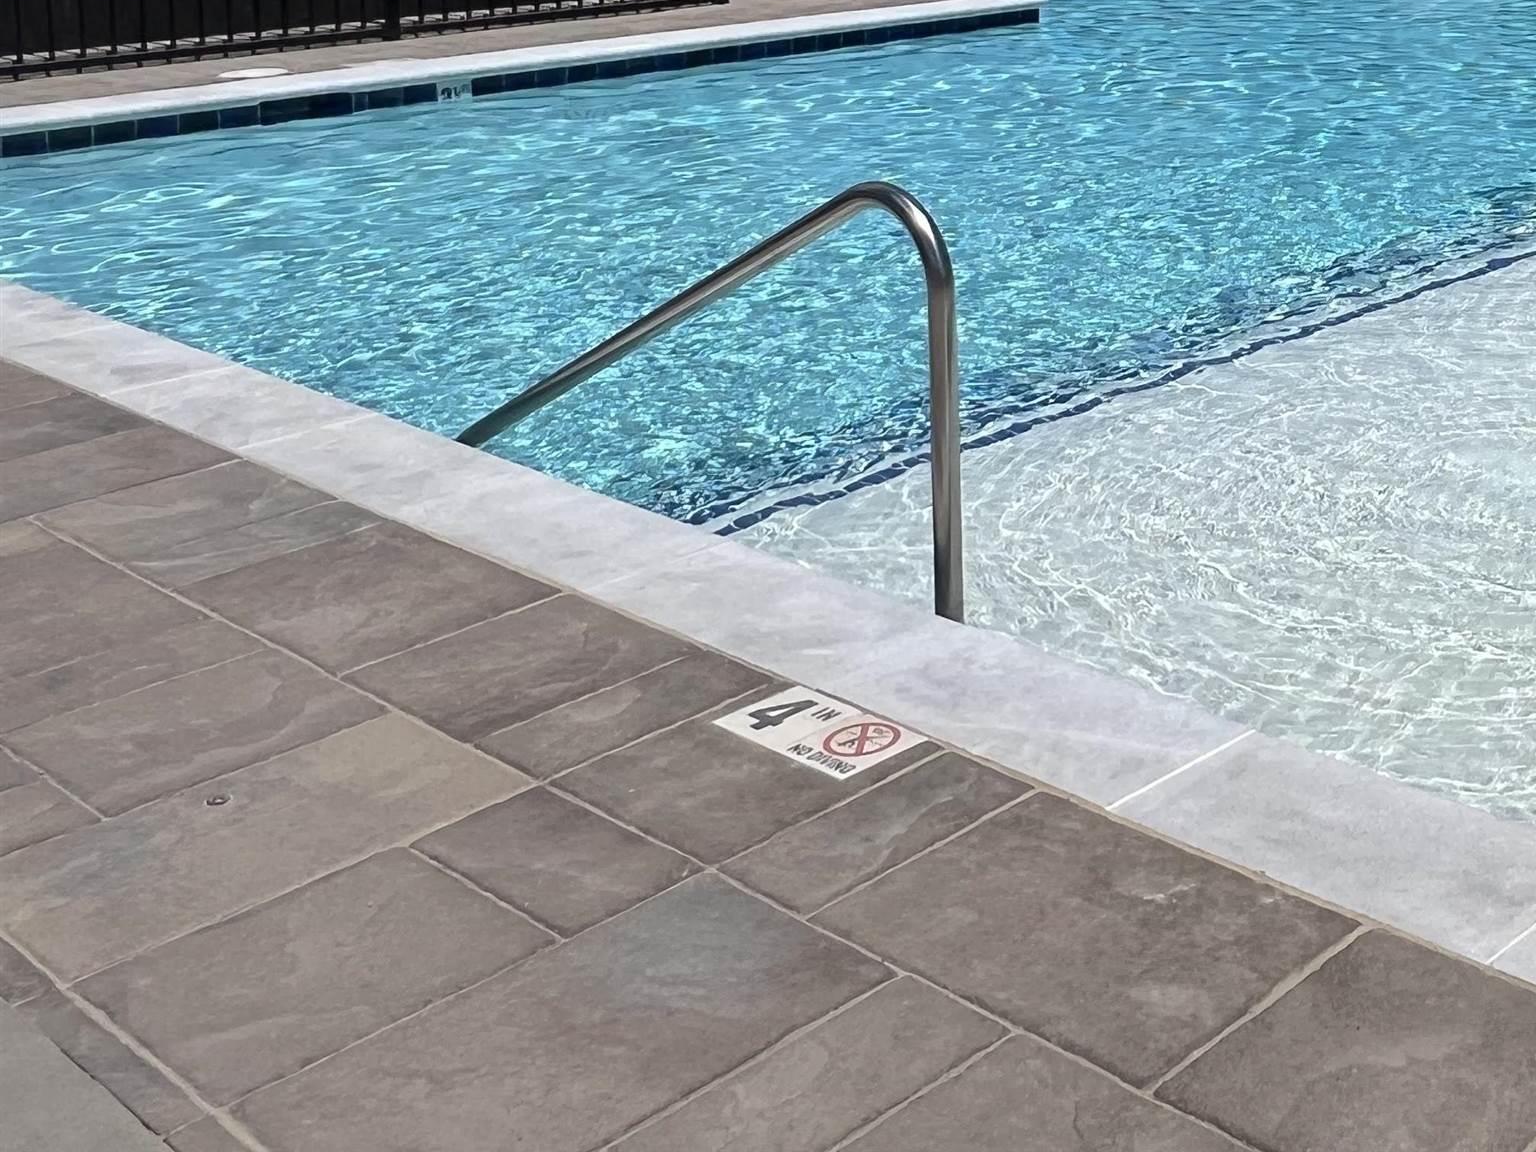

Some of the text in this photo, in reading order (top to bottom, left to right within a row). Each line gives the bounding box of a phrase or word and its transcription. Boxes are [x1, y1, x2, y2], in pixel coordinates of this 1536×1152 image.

[747, 699, 842, 731] 4 IN
[786, 743, 857, 774] NO DIVING
